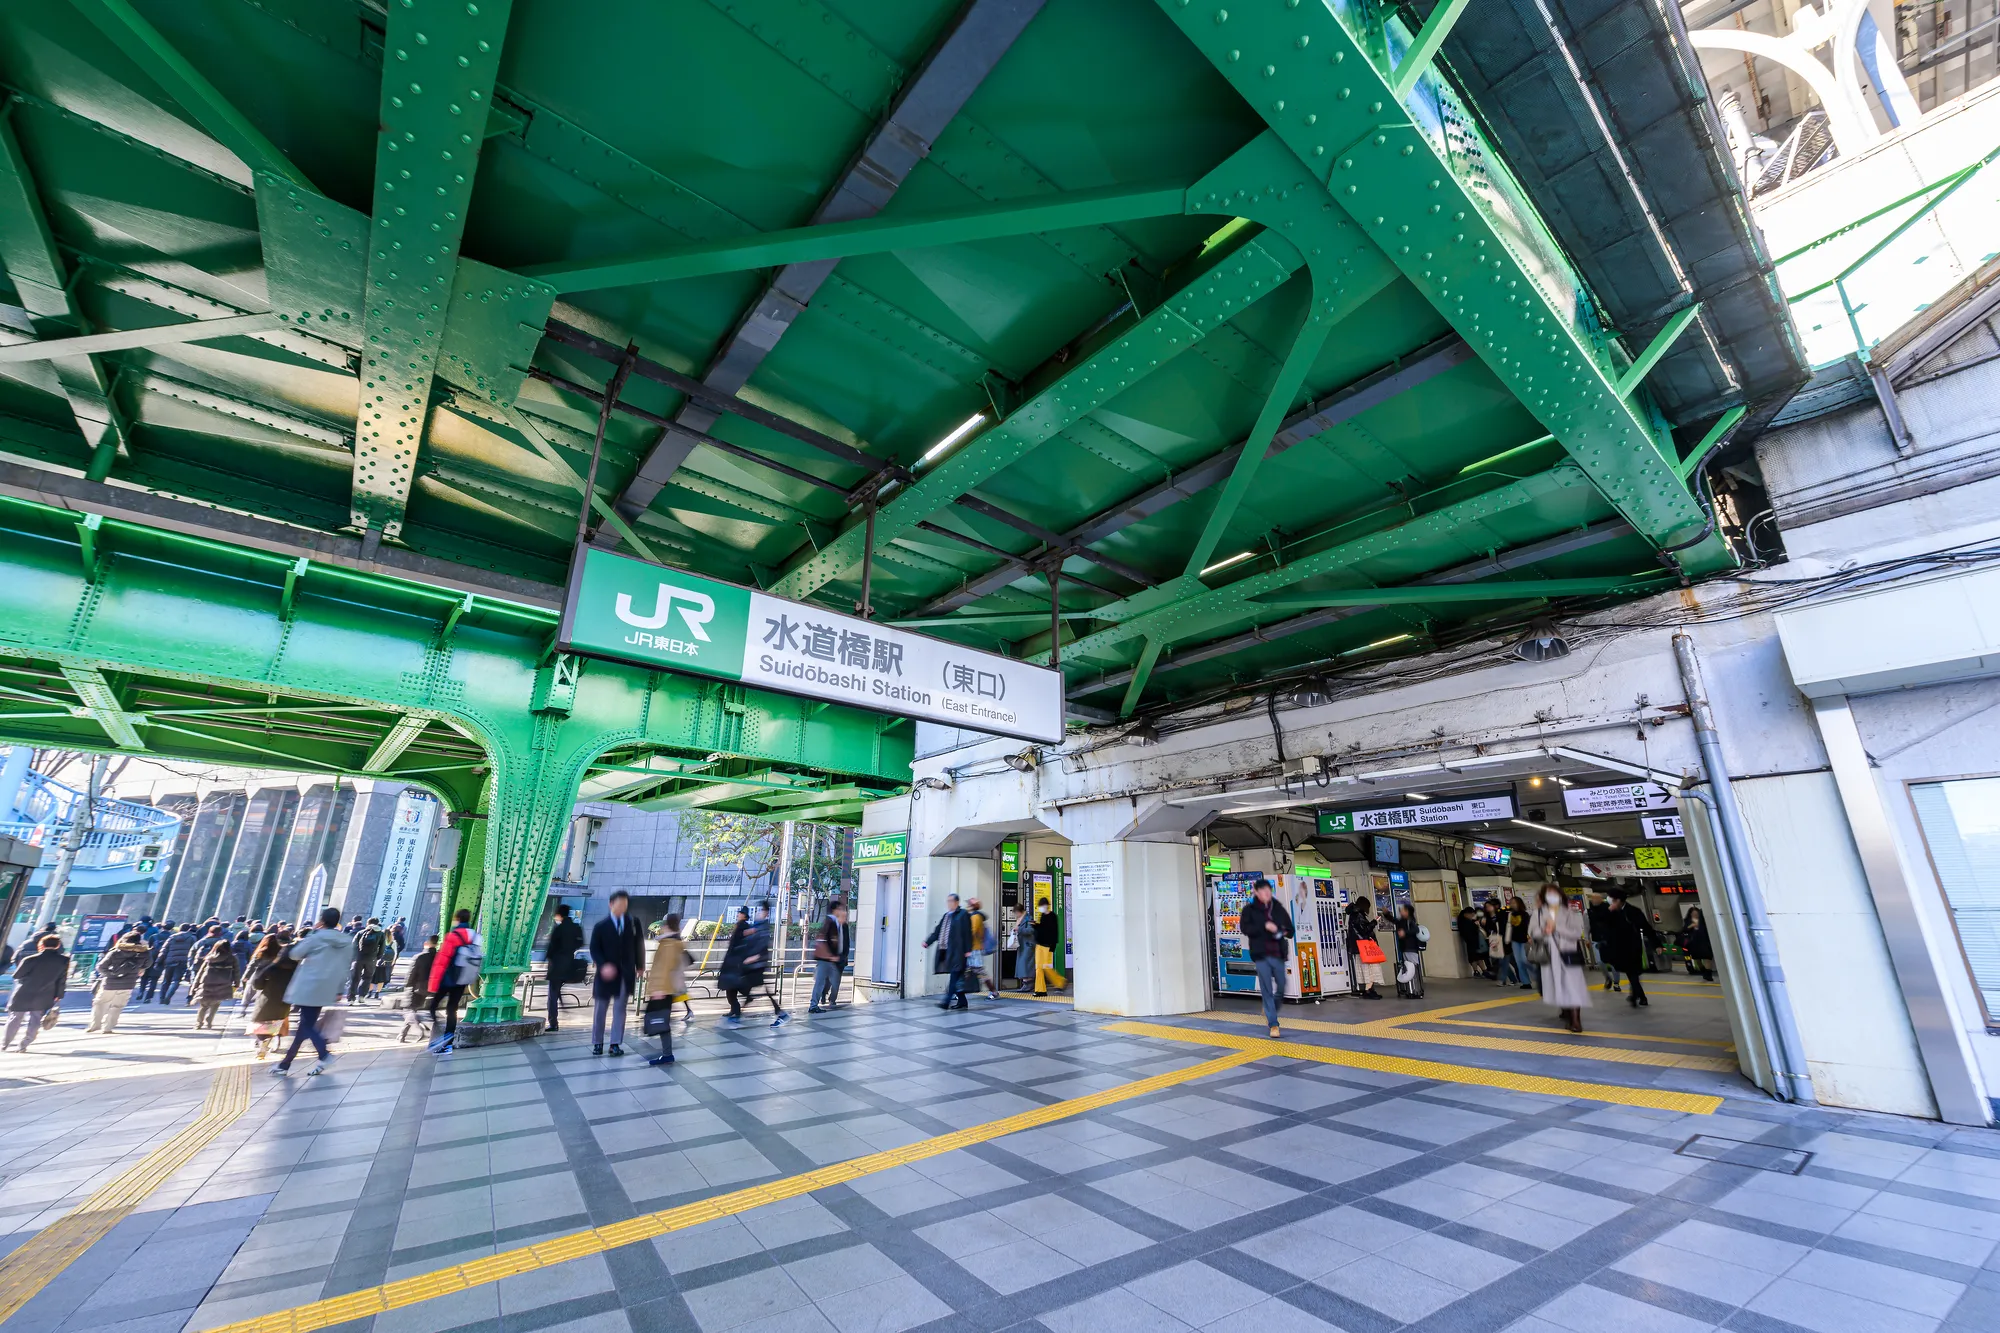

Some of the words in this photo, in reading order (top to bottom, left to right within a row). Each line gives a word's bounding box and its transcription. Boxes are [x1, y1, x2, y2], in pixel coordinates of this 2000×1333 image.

[615, 582, 715, 643] JR
[624, 631, 700, 657] JR東日本
[762, 613, 903, 678] 水道橋駅
[759, 654, 867, 692] Suidōbashi
[872, 678, 931, 706] Station
[942, 660, 1006, 701] （東口）
[941, 696, 969, 714] (East
[971, 703, 1017, 724] Entrance)
[1589, 787, 1630, 796] みどりの窓口
[1329, 815, 1347, 827] JR
[1360, 809, 1417, 828] 水道橋駅
[1420, 814, 1449, 823] Station
